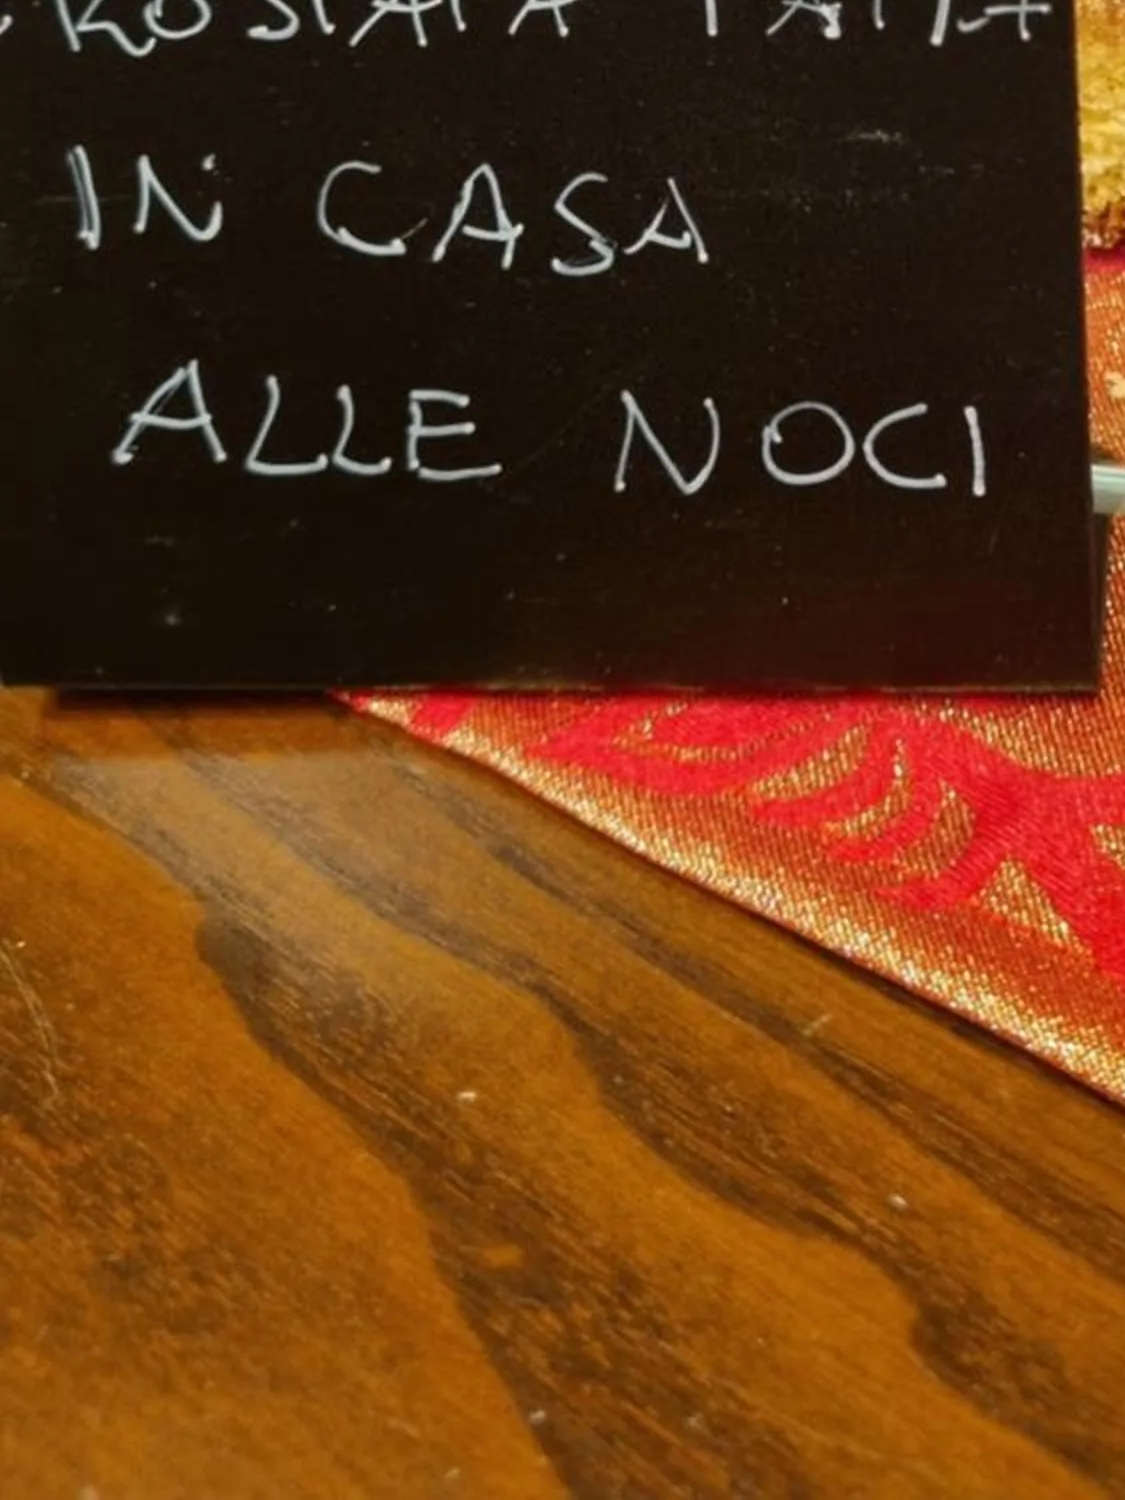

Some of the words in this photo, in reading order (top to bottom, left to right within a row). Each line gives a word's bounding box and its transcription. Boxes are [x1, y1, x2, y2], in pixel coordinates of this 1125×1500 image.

[67, 144, 223, 250] IN
[317, 161, 709, 276] CASA
[113, 360, 502, 481] ALLE
[615, 390, 986, 497] NOCI
